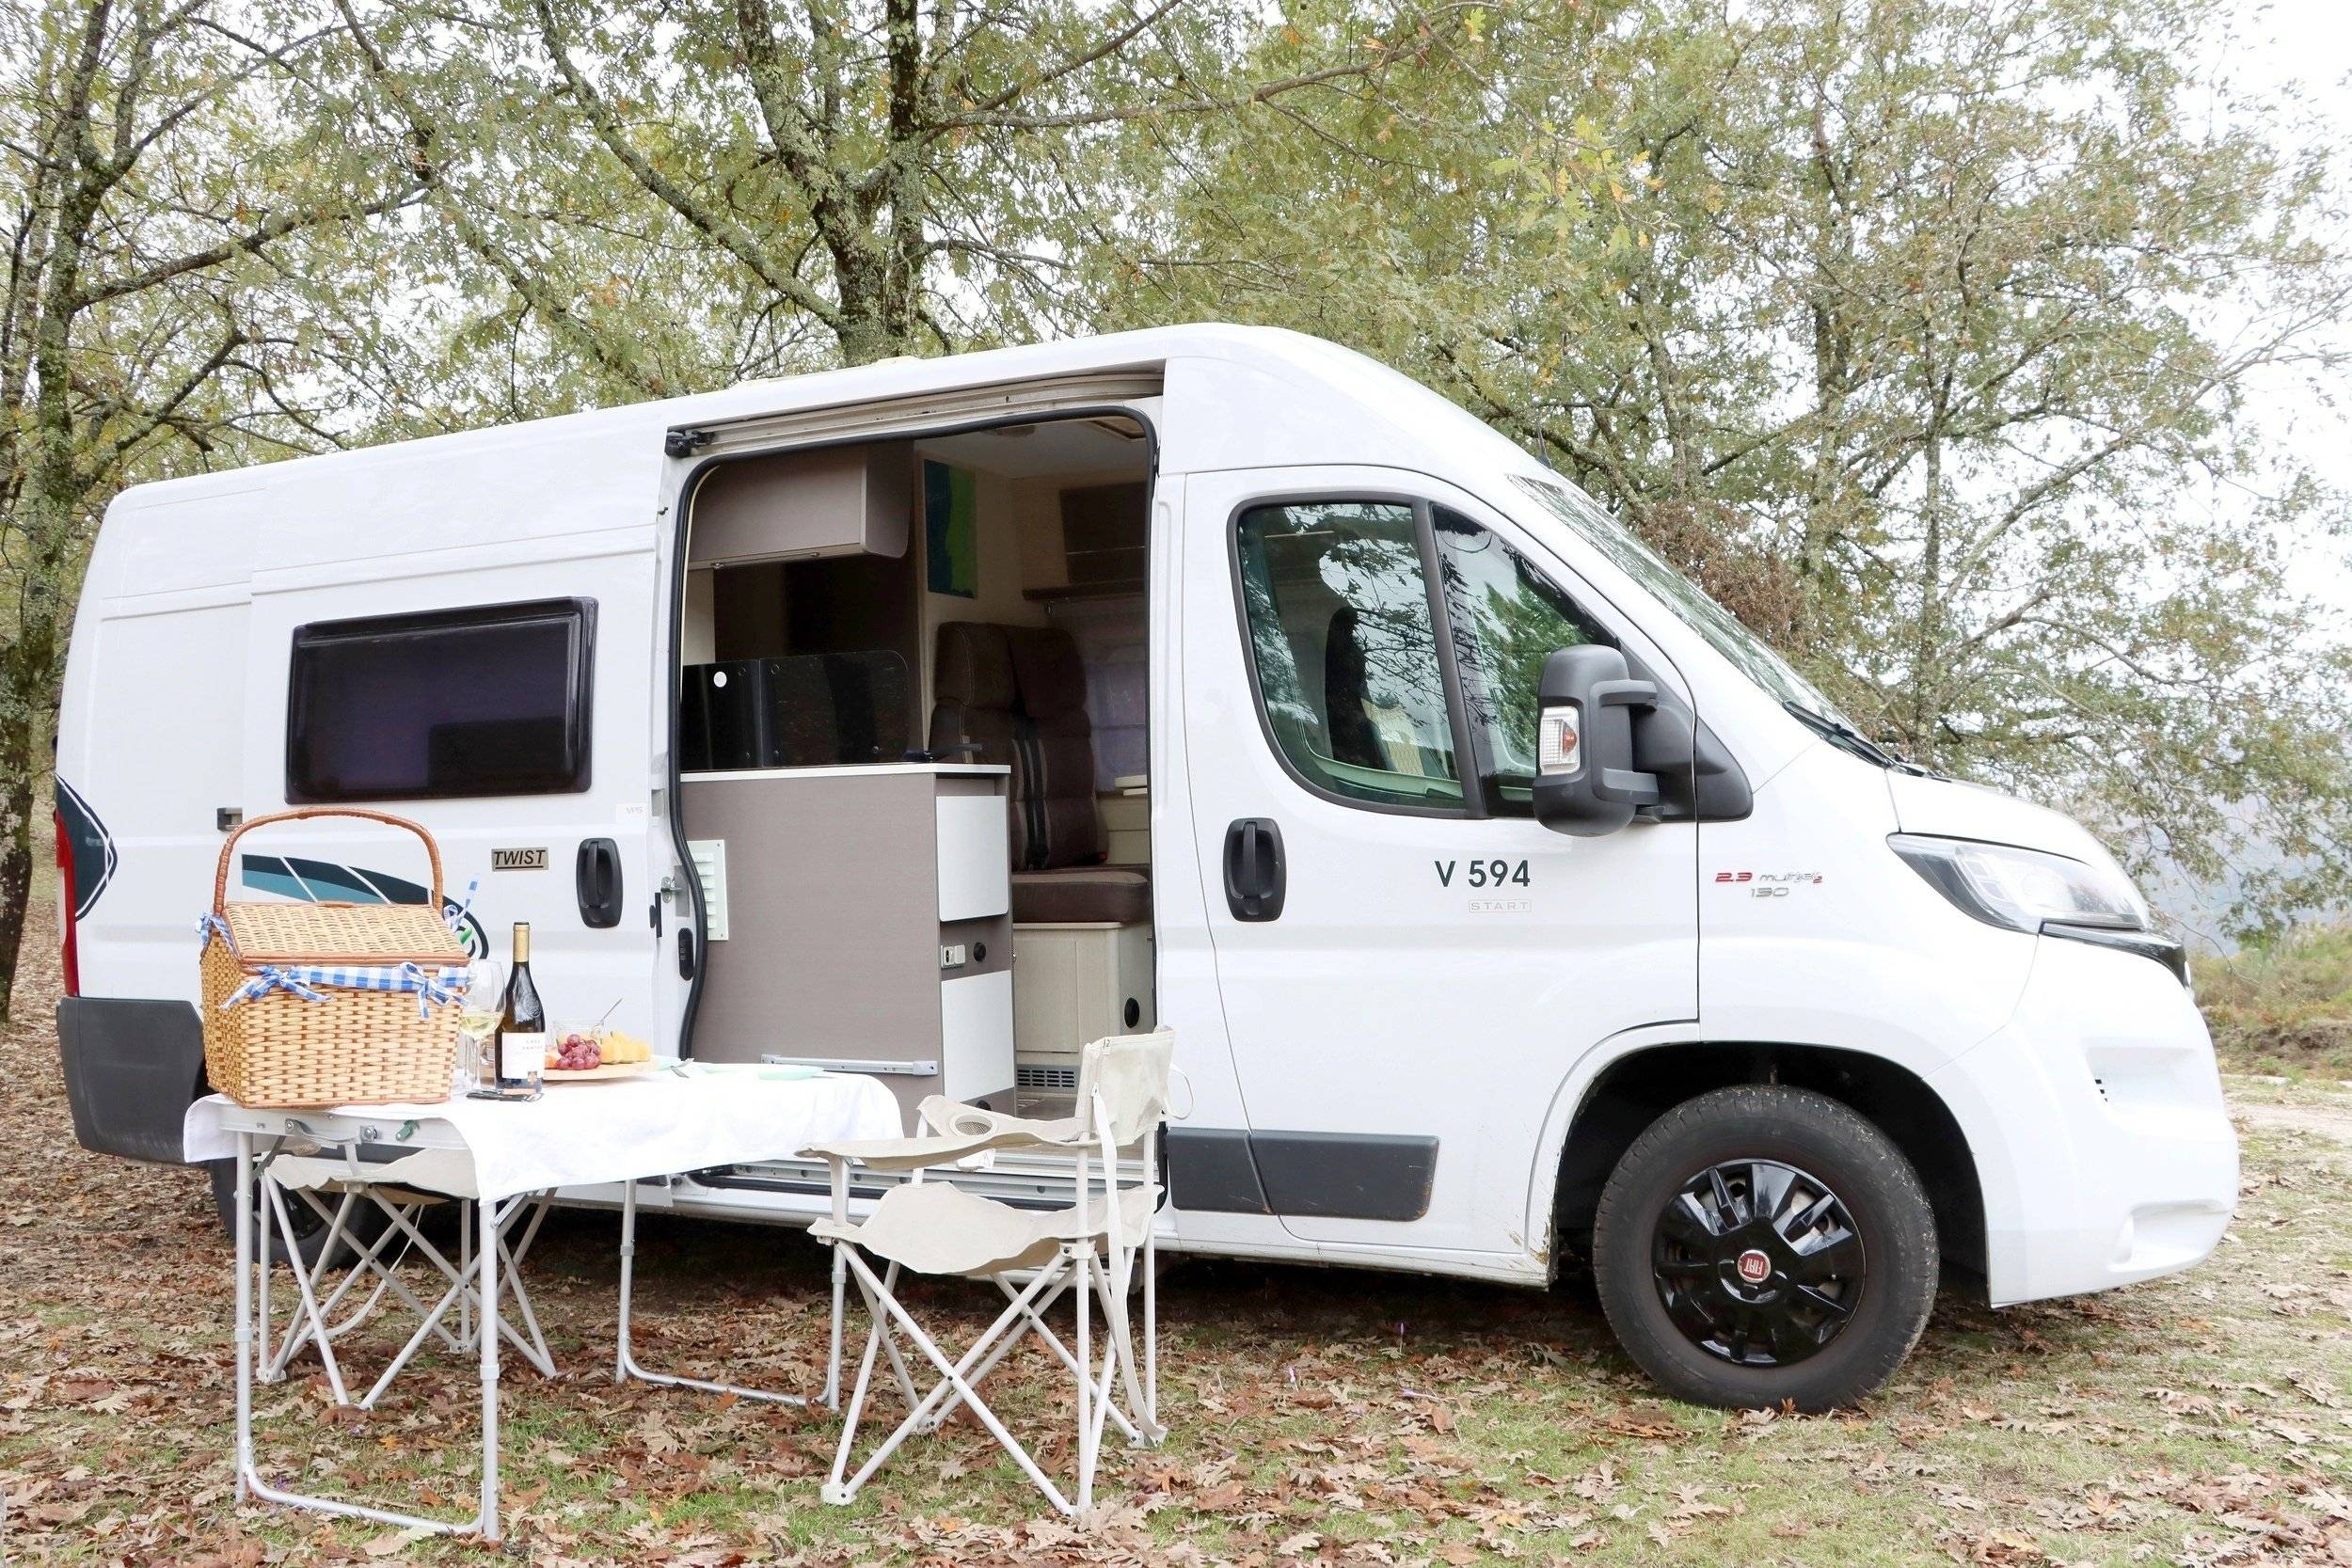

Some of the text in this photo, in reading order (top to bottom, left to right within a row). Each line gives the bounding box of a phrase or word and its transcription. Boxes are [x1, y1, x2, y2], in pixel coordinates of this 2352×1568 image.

[493, 849, 547, 866] TWIST
[1434, 859, 1532, 888] V 594
[1470, 901, 1529, 911] START
[1743, 1257, 1764, 1275] FIAT
